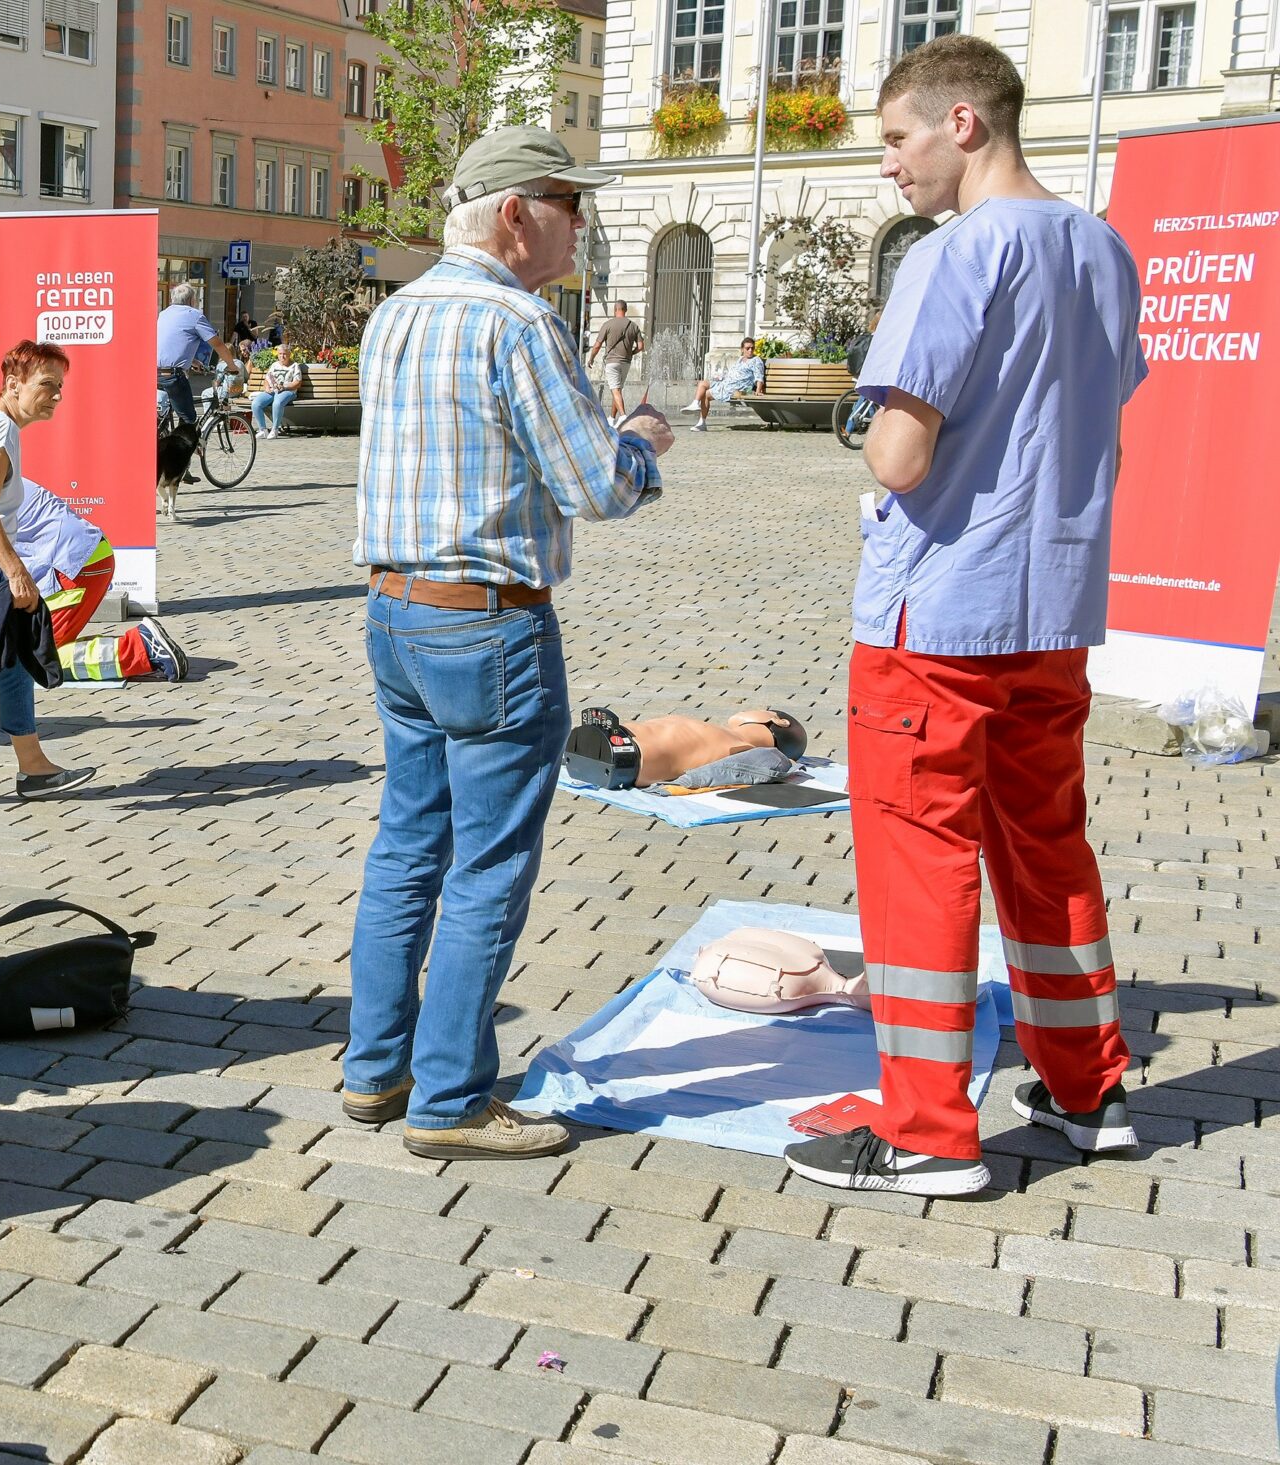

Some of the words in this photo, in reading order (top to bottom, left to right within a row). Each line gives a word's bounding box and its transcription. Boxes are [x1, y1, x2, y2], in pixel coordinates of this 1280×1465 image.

[1153, 211, 1280, 233] HERZSTILLSTAND?
[1145, 250, 1255, 285] PRÜFEN
[1139, 293, 1231, 323] RUFEN
[43, 316, 72, 331] 100
[1138, 327, 1261, 361] DRÜCKEN
